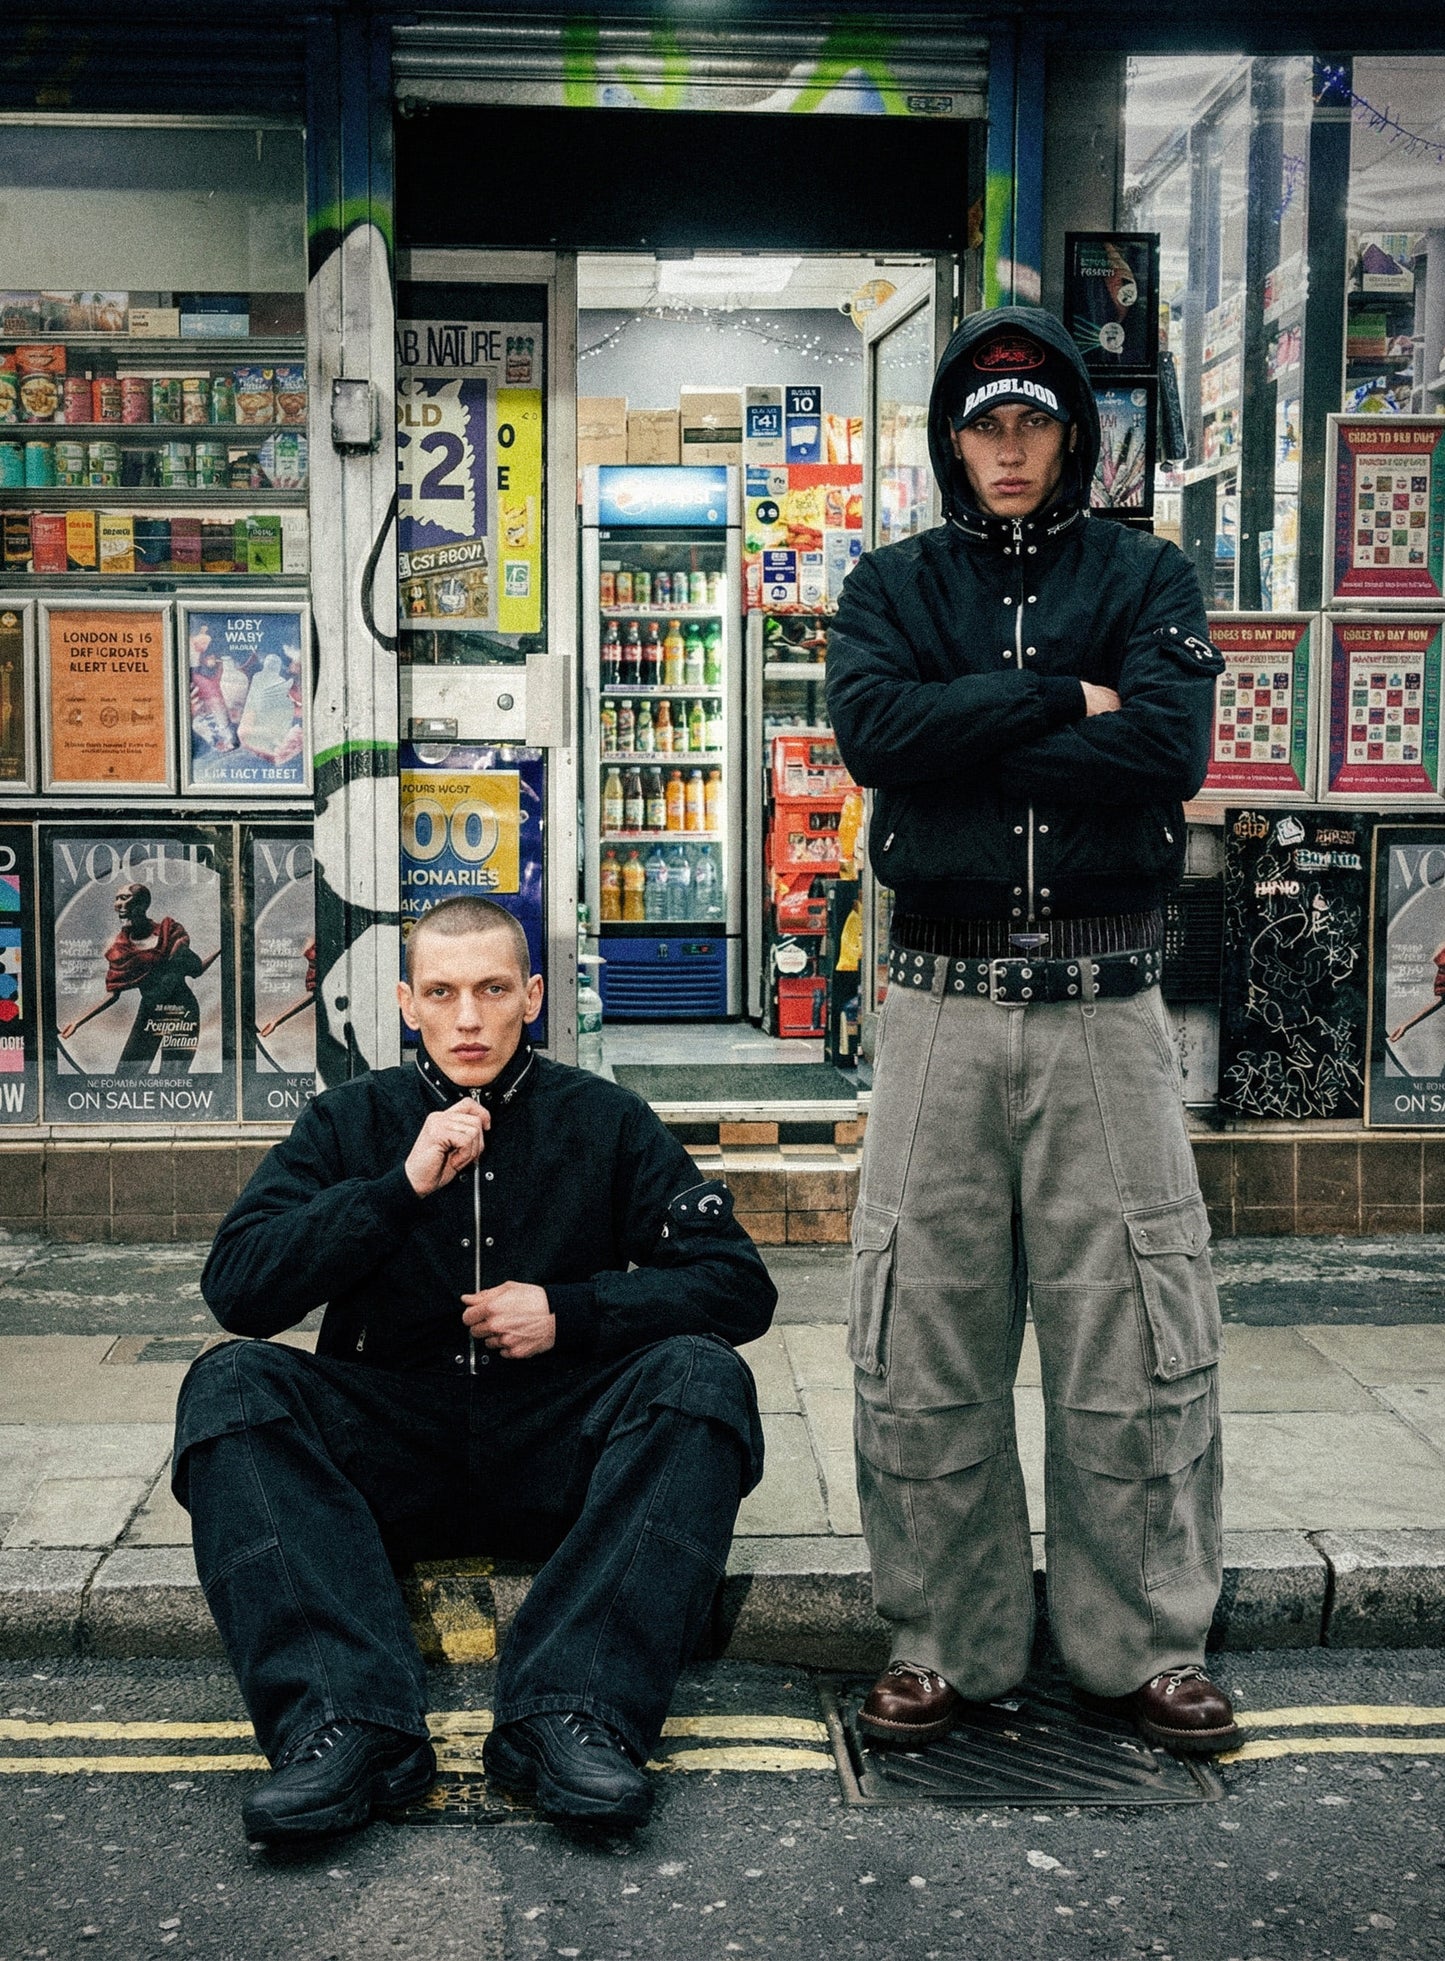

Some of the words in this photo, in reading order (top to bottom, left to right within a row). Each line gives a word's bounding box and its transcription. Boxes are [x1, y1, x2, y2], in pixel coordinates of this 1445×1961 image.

[427, 325, 501, 366] NATURE
[792, 397, 814, 412] 10
[963, 378, 1059, 417] BADBLOOD
[63, 632, 118, 643] LONDON
[122, 633, 134, 643] IS
[111, 662, 149, 672] LEVEL
[59, 843, 216, 886] VOGUE
[68, 1091, 100, 1110] ON
[105, 1091, 156, 1110] SALE
[160, 1090, 213, 1109] NOW
[268, 1090, 299, 1108] ON
[1395, 1095, 1425, 1112] ON
